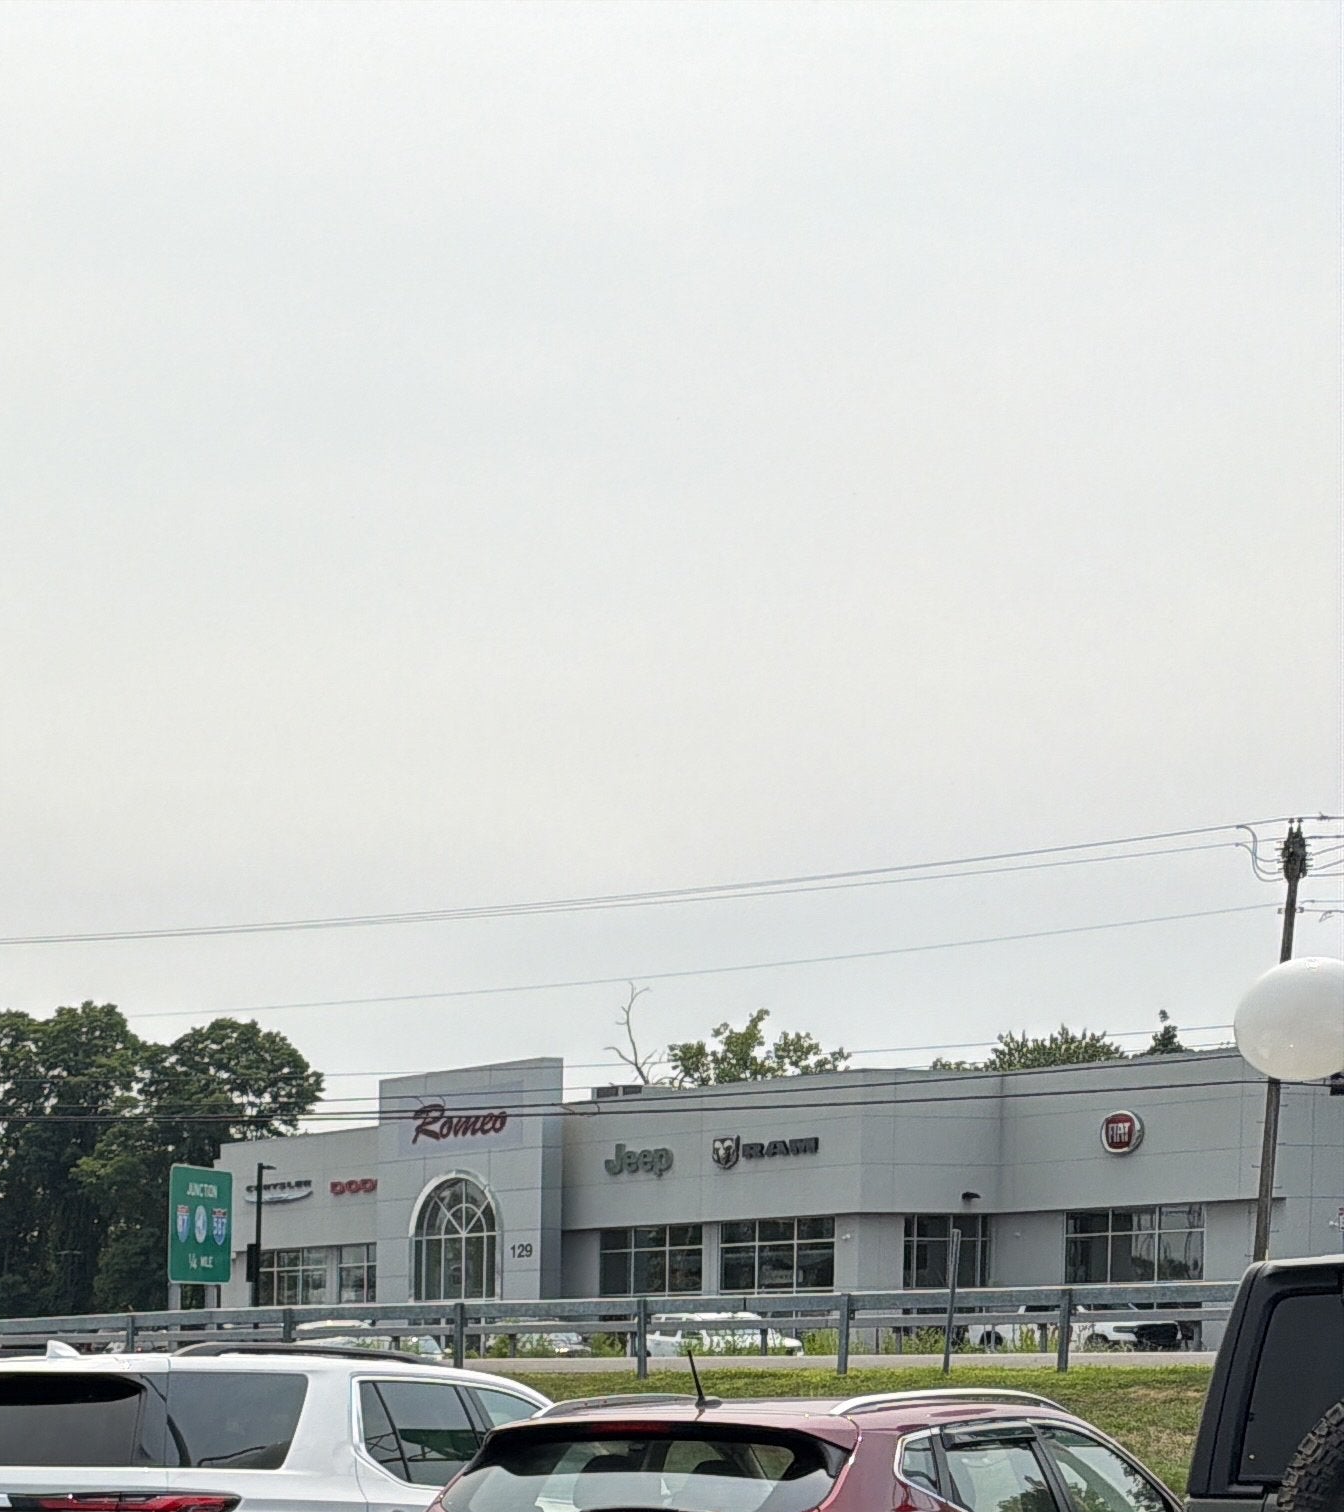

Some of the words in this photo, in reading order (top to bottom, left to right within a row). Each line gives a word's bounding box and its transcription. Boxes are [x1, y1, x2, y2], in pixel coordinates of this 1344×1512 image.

[412, 1103, 508, 1144] Romeo
[1108, 1122, 1131, 1144] FIAT
[741, 1137, 820, 1159] RAM
[604, 1143, 675, 1177] Jeep
[330, 1178, 378, 1195] DOD
[510, 1243, 533, 1259] 129
